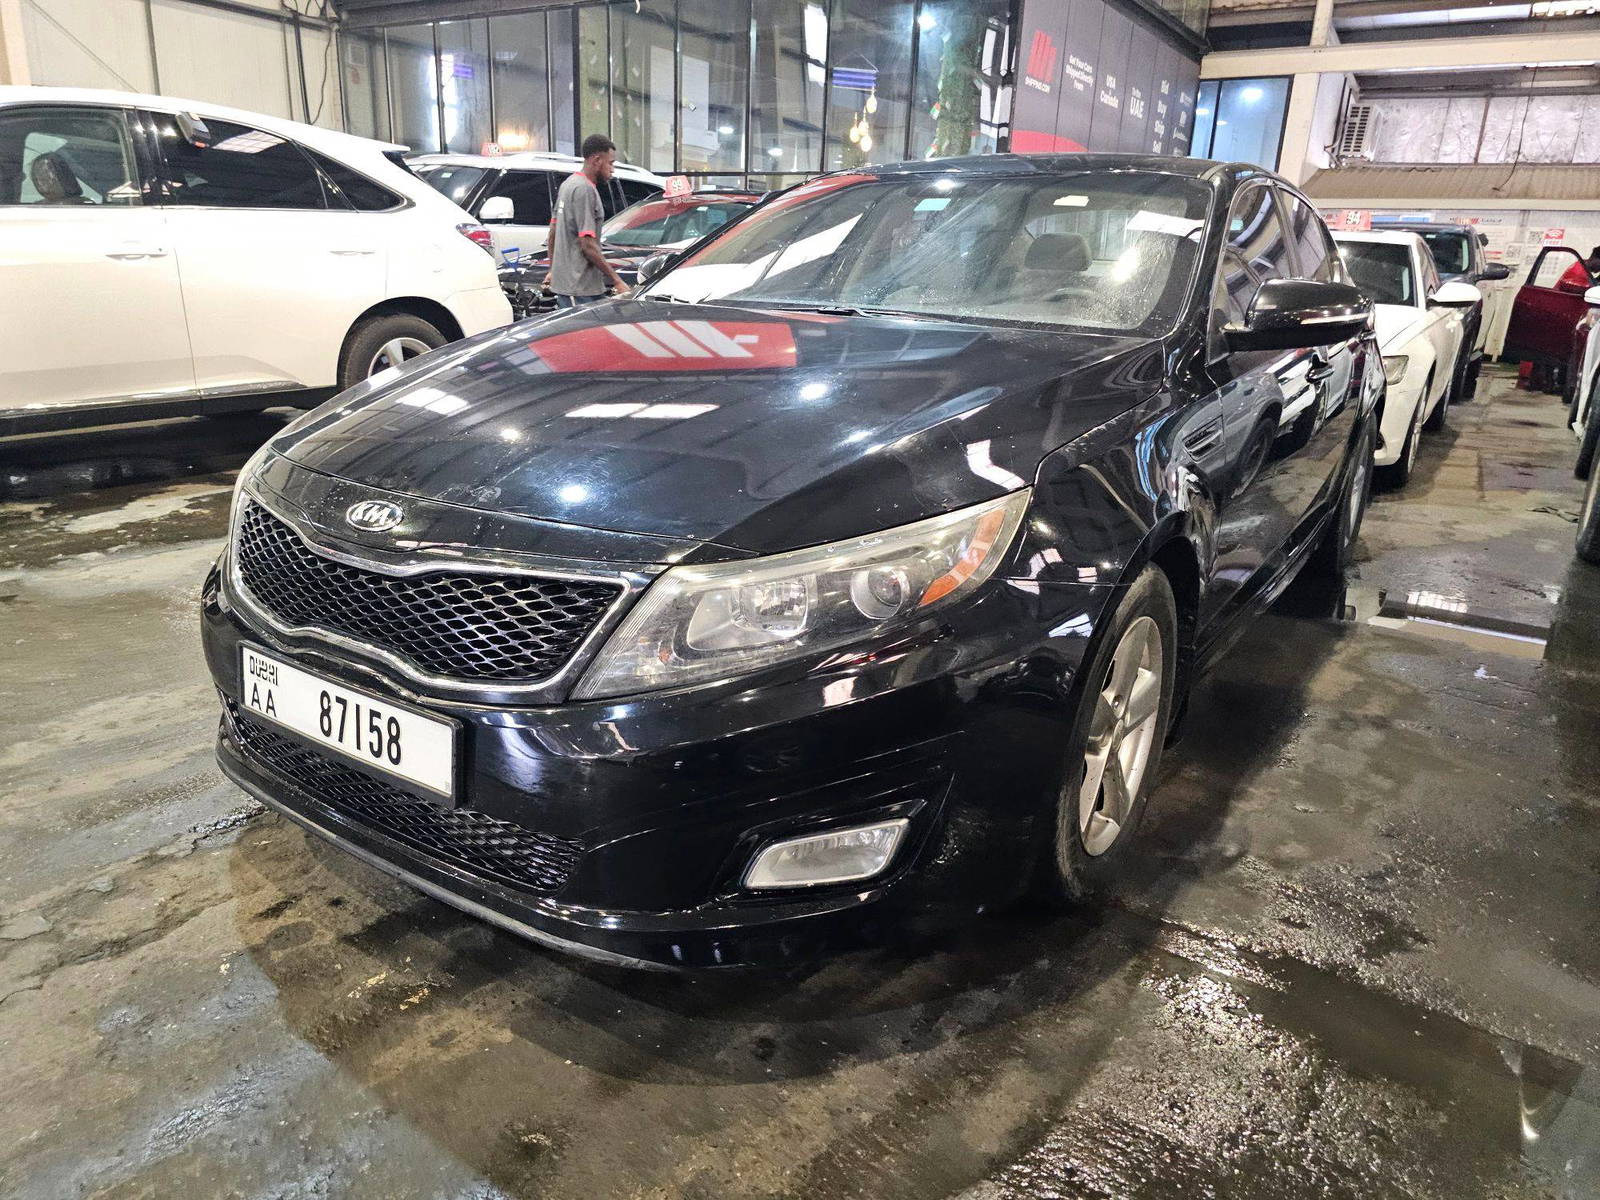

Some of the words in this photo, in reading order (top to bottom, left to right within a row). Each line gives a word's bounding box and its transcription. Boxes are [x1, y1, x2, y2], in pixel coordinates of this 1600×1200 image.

[1106, 75, 1116, 89] USA
[1100, 90, 1119, 108] Canada
[1130, 96, 1145, 119] UAE
[1157, 100, 1167, 119] Buy
[1154, 120, 1165, 139] Ship
[1152, 140, 1162, 154] Sell
[319, 690, 402, 765] 87158
